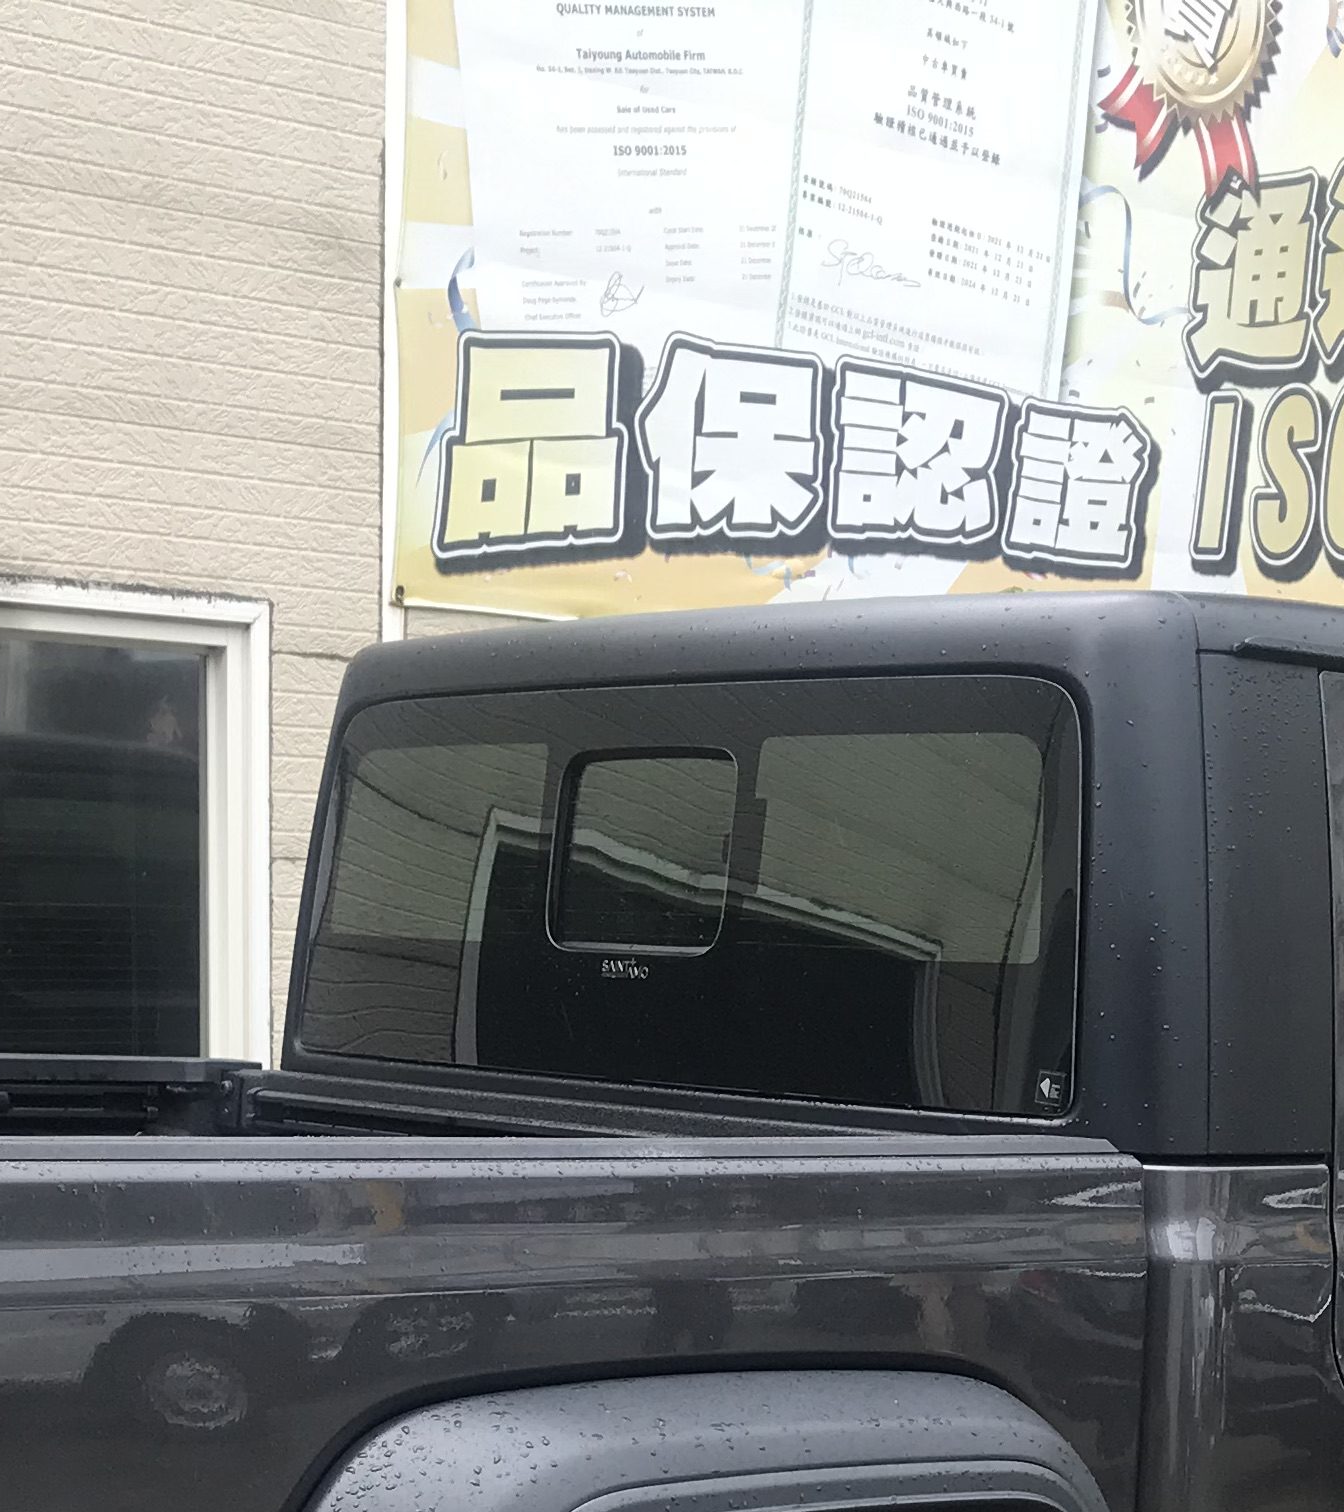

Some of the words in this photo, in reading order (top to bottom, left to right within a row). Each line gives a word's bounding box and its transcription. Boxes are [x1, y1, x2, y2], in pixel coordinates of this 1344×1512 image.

[556, 3, 601, 16] QUALITY
[605, 5, 674, 17] MANAGEMENT
[678, 6, 716, 17] SYSTEM
[576, 48, 622, 62] Taiyoung
[625, 49, 681, 61] Automobile
[684, 50, 706, 61] Firm
[907, 84, 976, 120] 品質管理系統
[906, 104, 925, 120] ISO
[927, 112, 974, 137] 9001:2015
[612, 145, 632, 156] ISO
[635, 144, 687, 156] 9001:2015
[433, 331, 1151, 572] 品保認證
